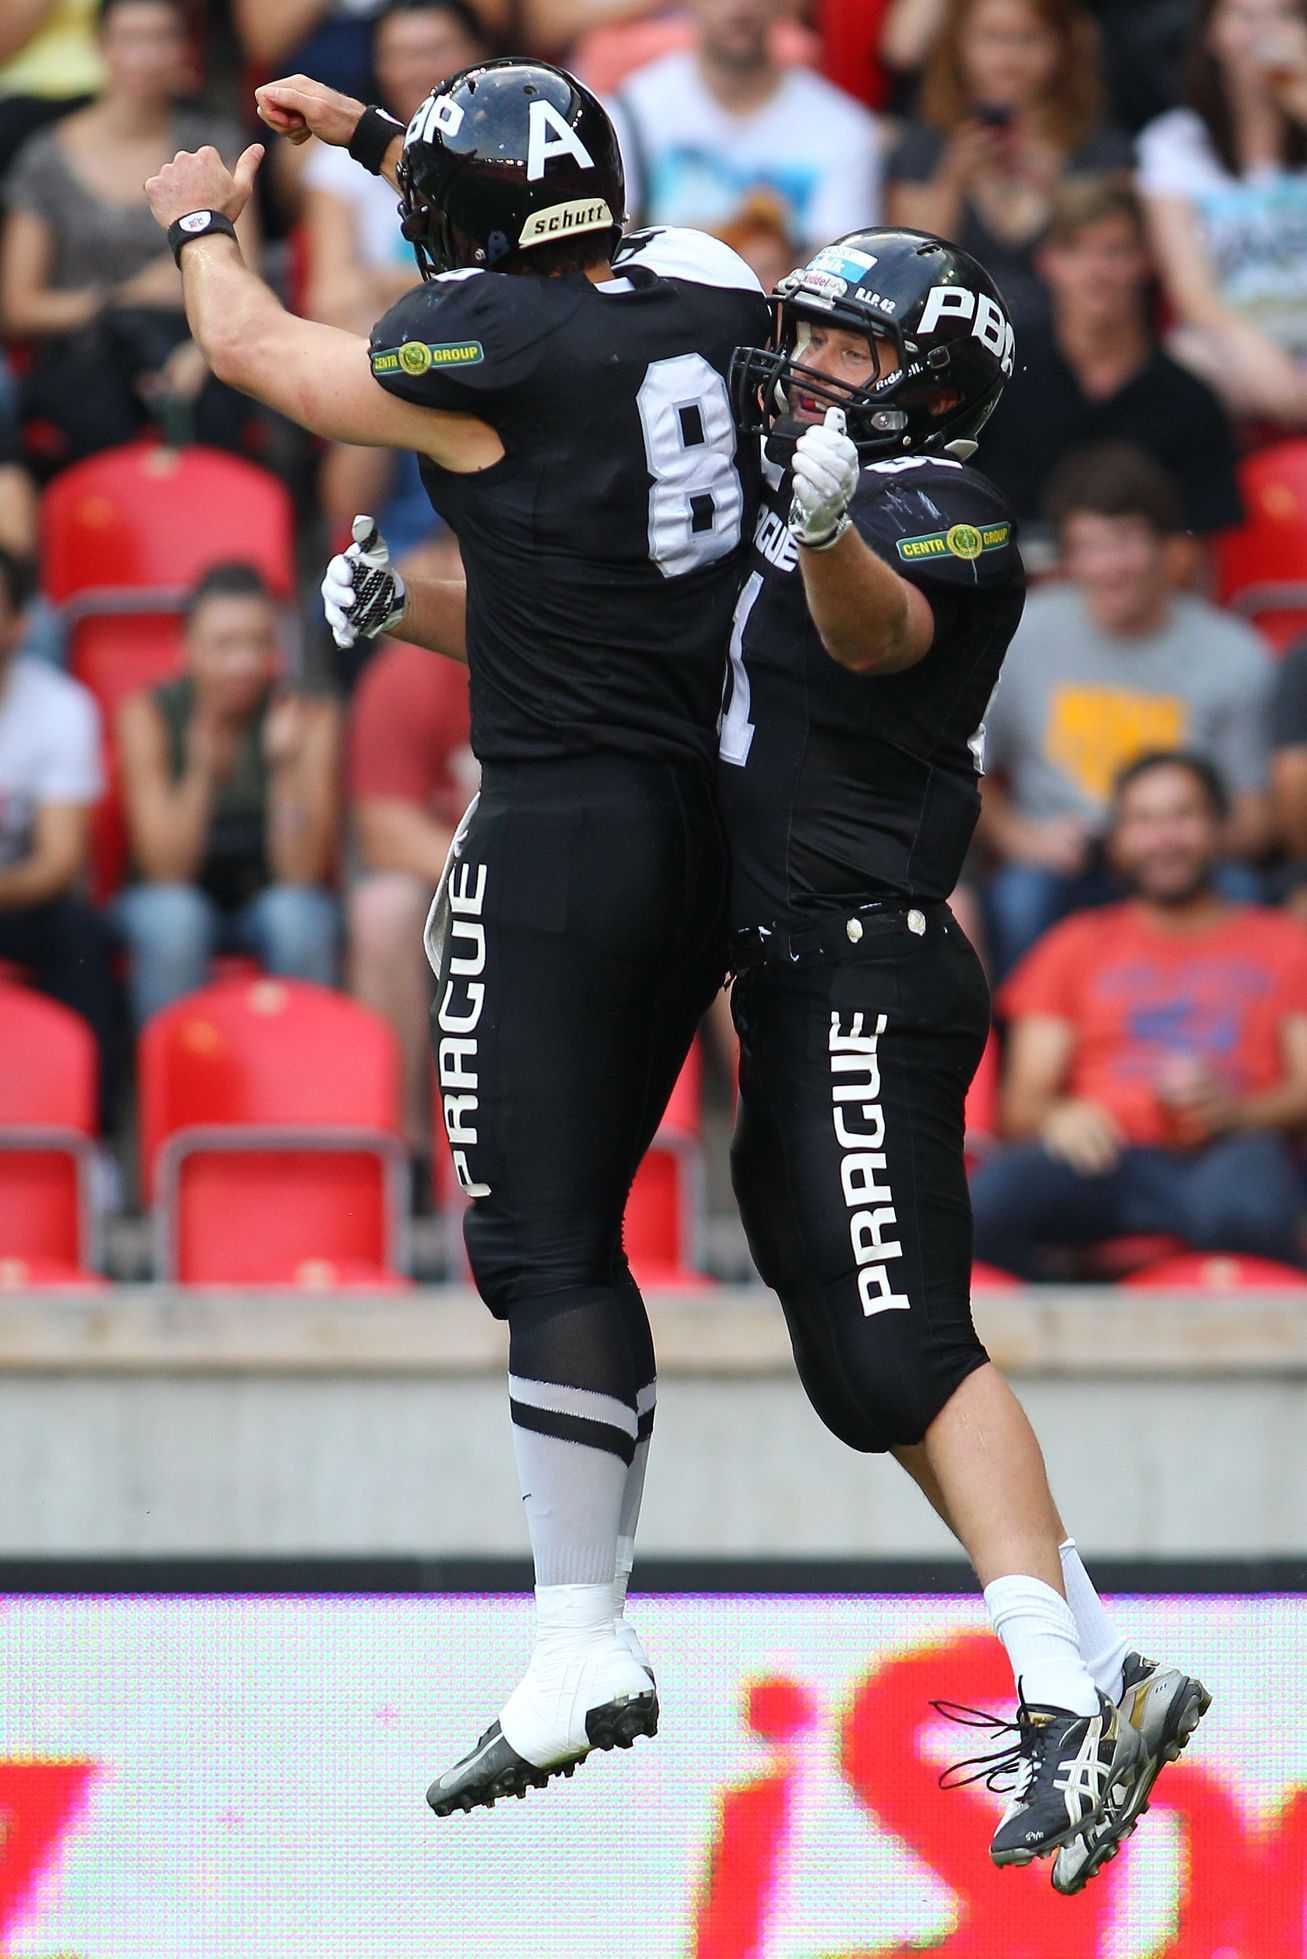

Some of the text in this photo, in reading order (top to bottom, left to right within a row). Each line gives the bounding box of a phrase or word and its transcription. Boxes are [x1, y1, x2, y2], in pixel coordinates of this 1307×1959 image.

[527, 99, 595, 181] A
[534, 204, 604, 235] schutt
[855, 286, 897, 315] R.I.P. 42
[433, 346, 479, 363] GROUP
[636, 352, 743, 578] 8
[902, 538, 946, 556] CENTR
[438, 863, 492, 1198] PRAGUE
[829, 1010, 911, 1317] PRAGUE
